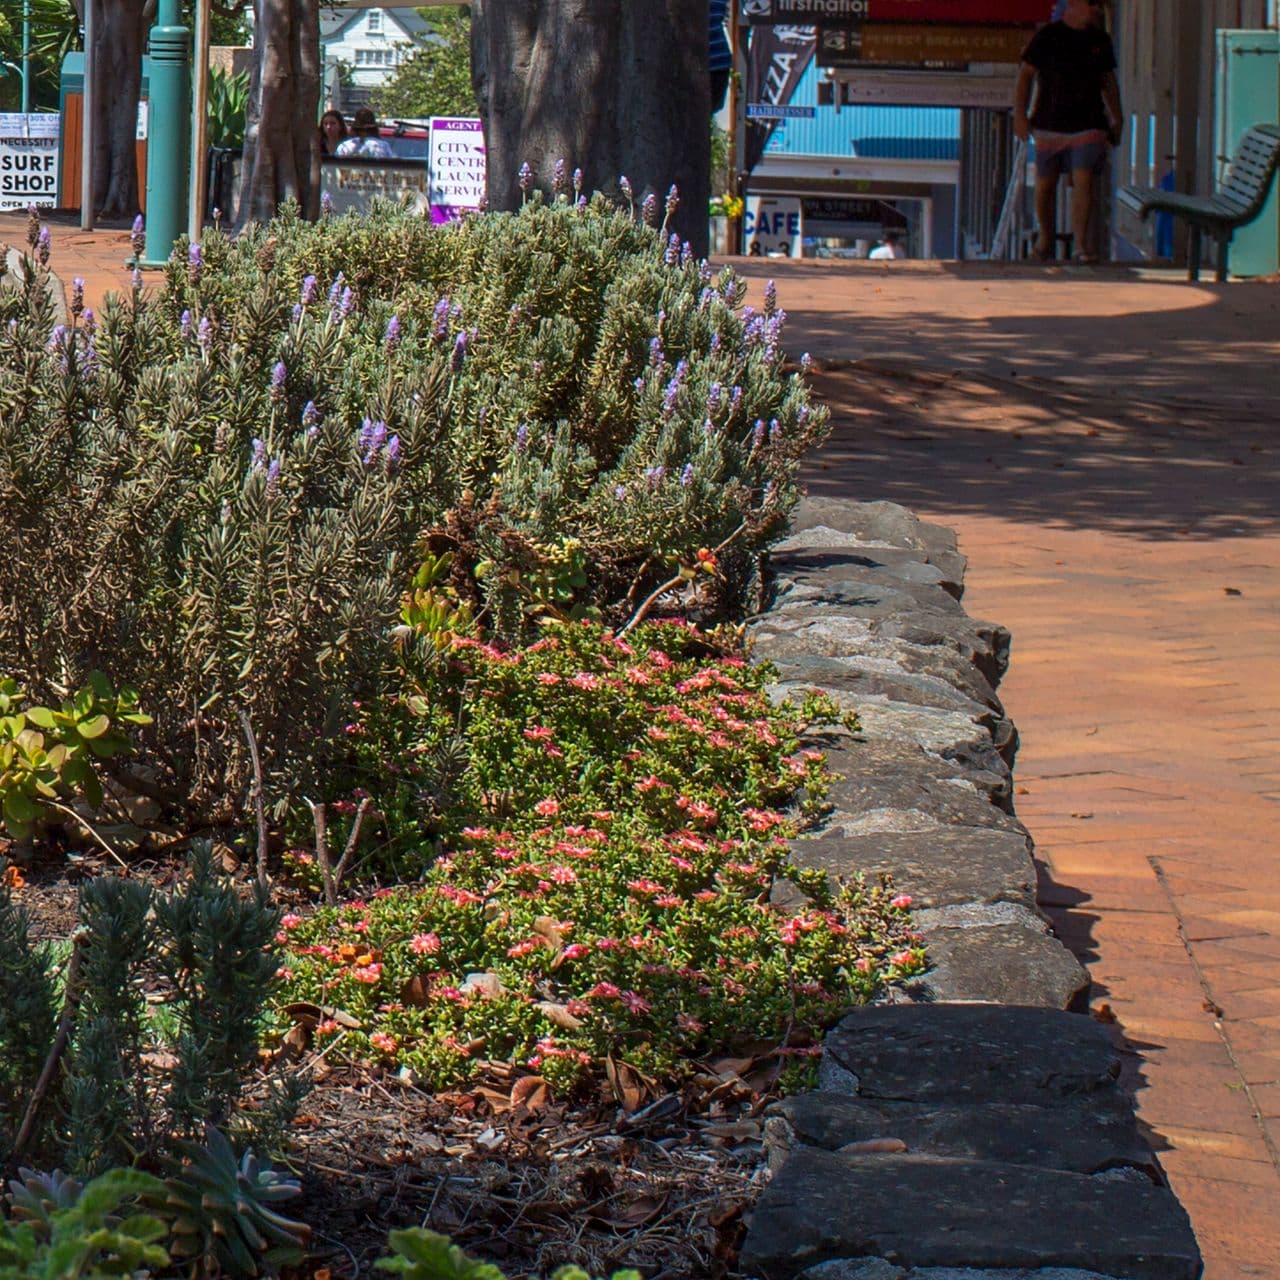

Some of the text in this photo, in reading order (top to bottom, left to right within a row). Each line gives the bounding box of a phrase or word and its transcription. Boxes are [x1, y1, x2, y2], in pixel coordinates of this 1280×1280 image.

[445, 122, 479, 131] AGENT
[0, 138, 55, 147] NECESSITY
[438, 142, 470, 154] CITY
[1, 155, 55, 172] SURF
[2, 175, 55, 191] SHOP
[743, 211, 800, 235] CAFE
